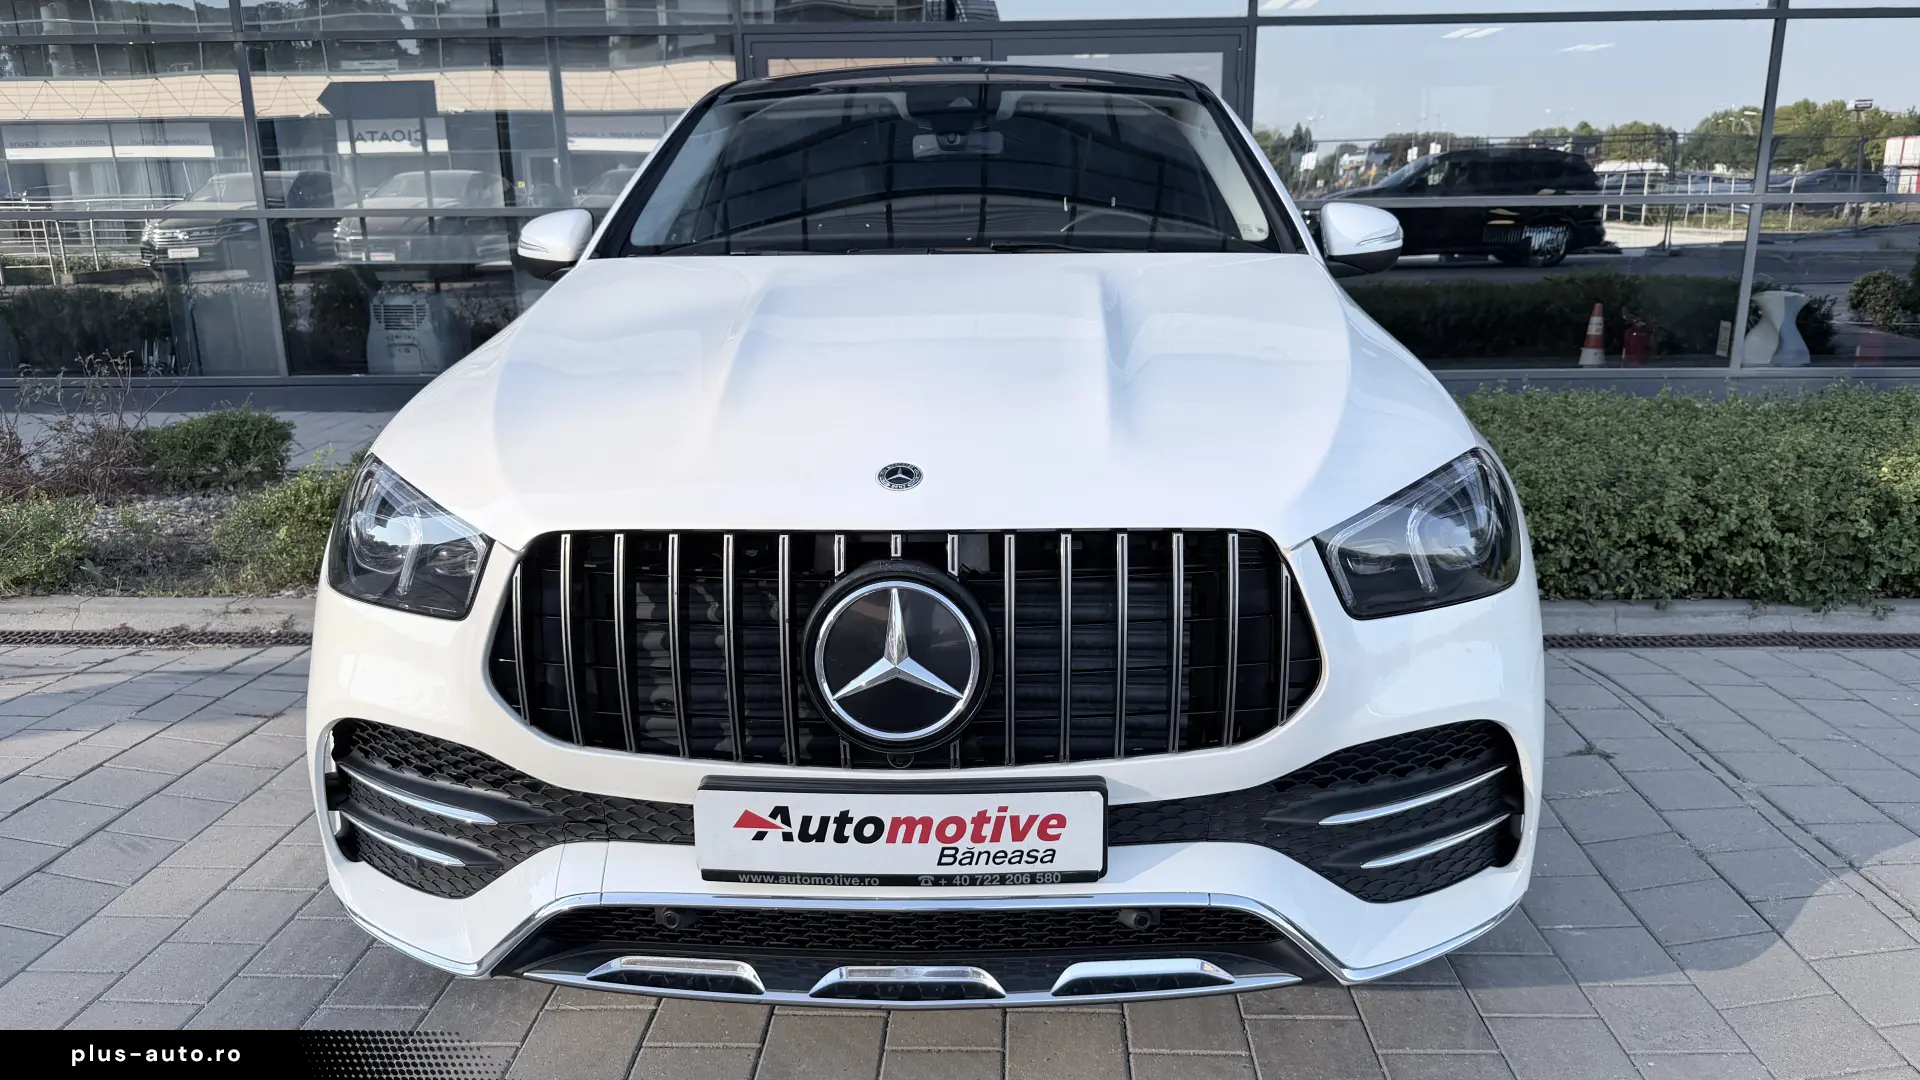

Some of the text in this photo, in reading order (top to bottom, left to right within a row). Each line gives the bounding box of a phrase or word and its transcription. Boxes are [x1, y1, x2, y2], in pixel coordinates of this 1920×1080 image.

[734, 806, 1067, 845] Automotive
[936, 846, 1057, 867] Băneasa
[738, 873, 880, 887] www.automotive.ro
[952, 875, 970, 886] 40
[974, 875, 1001, 886] 722
[1005, 873, 1031, 885] 206
[1035, 872, 1062, 884] 580
